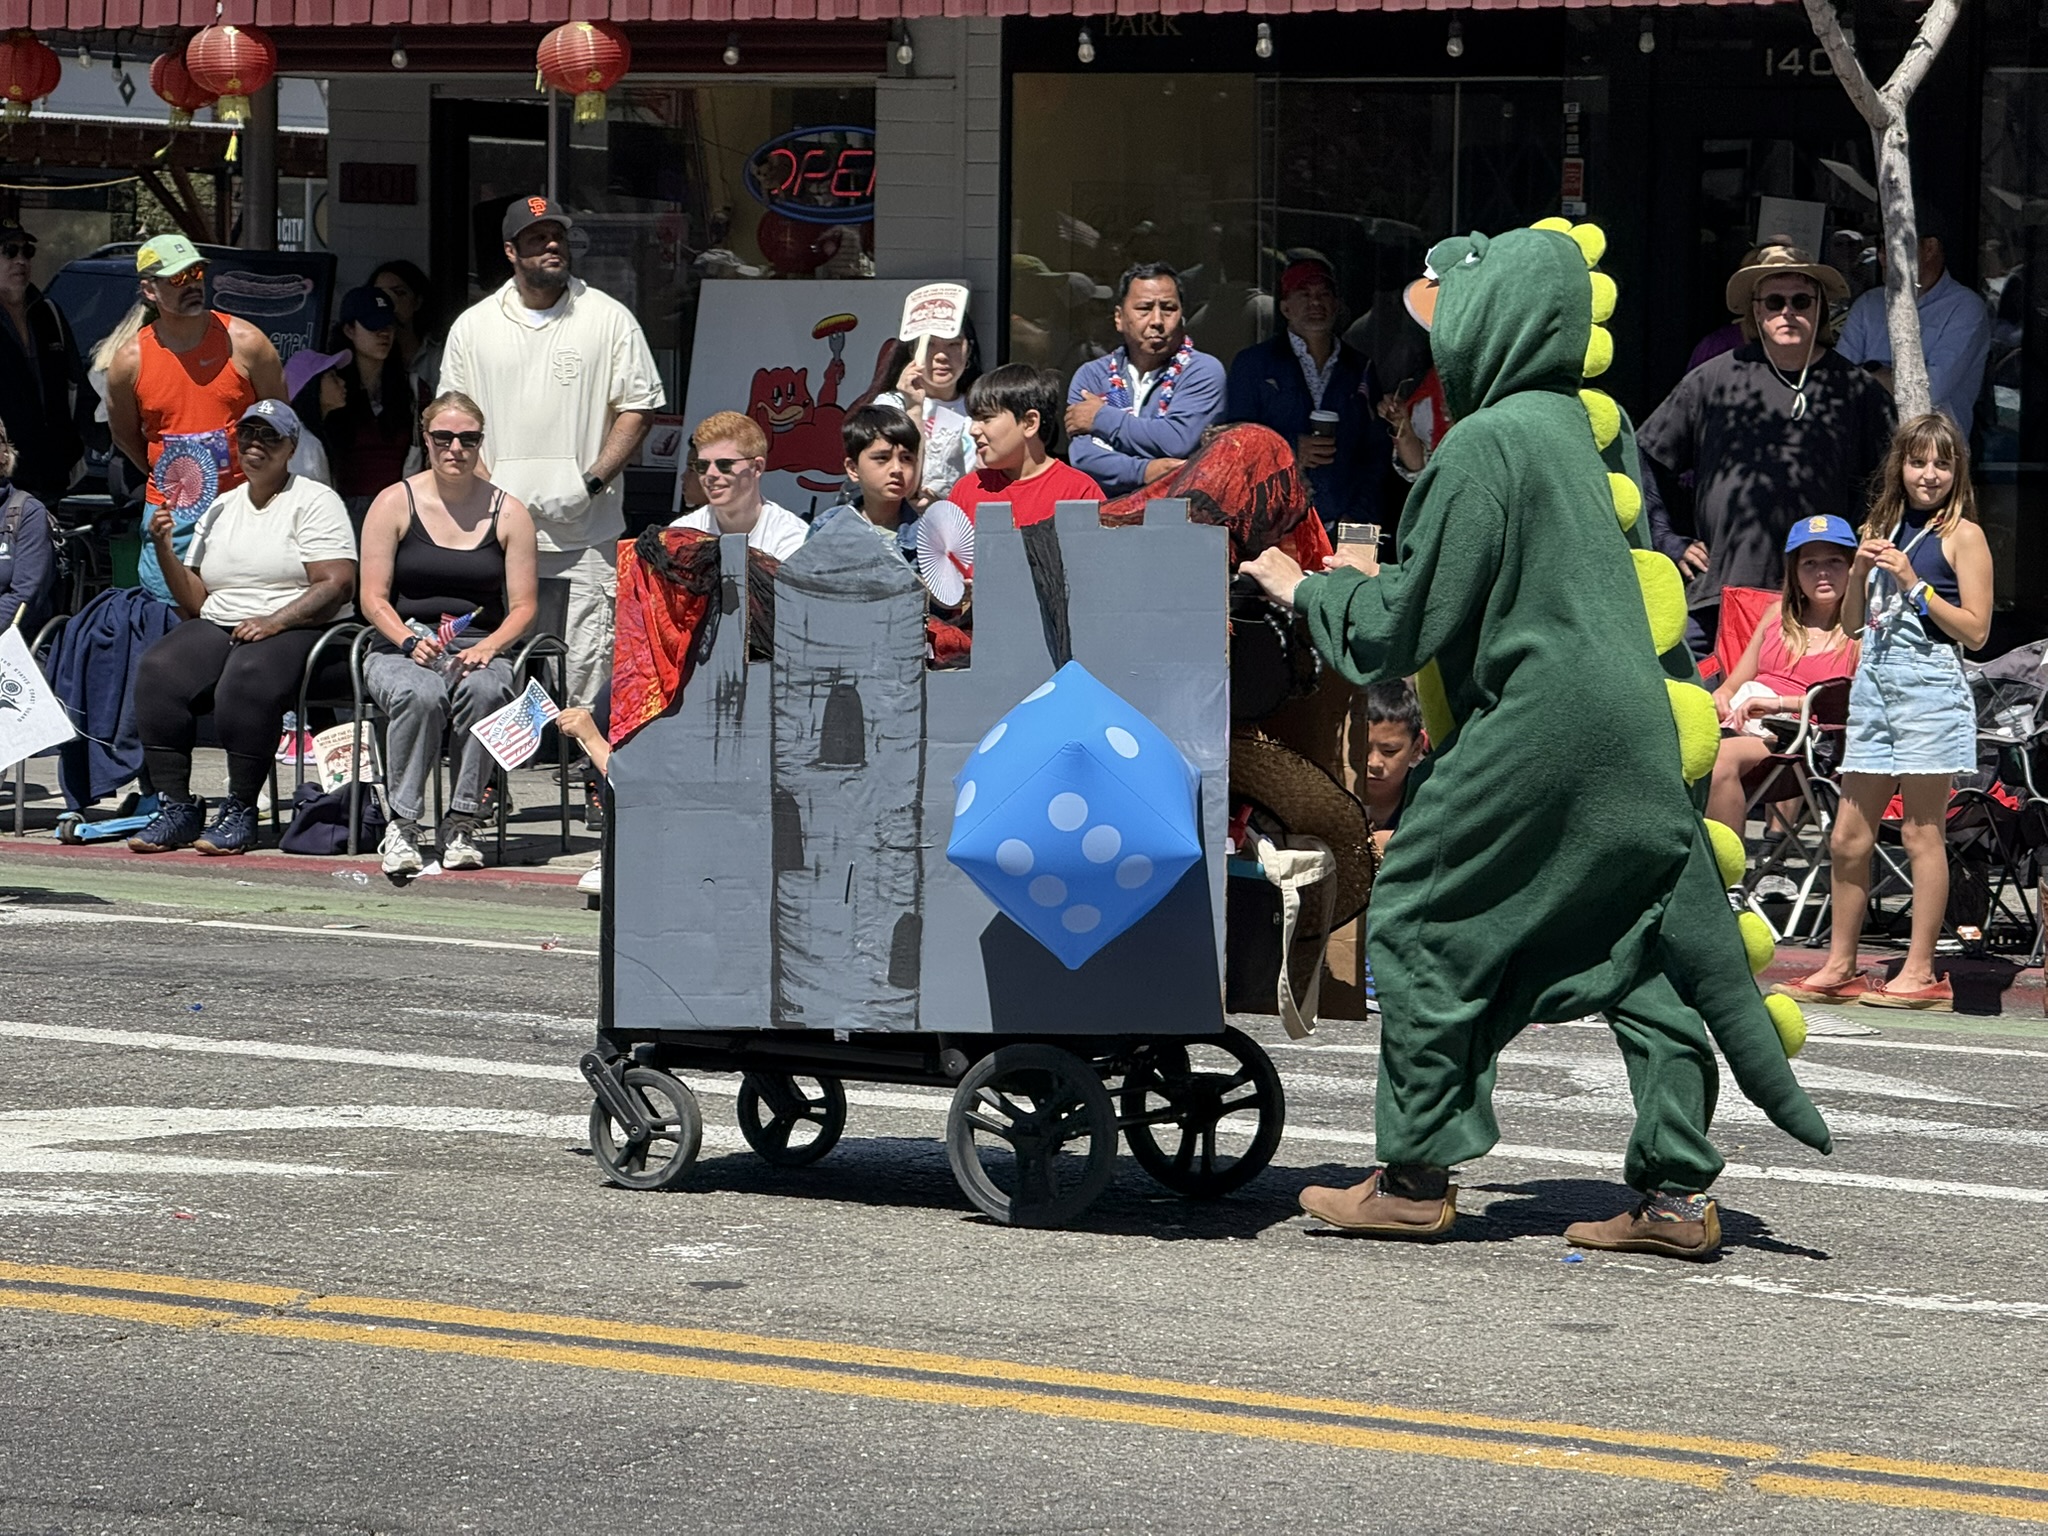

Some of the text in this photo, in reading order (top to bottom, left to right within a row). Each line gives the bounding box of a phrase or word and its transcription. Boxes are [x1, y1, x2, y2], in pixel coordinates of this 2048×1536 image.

[1104, 13, 1182, 36] PARK
[528, 196, 547, 217] SF
[258, 400, 274, 415] LA
[491, 726, 501, 739] NO
[500, 707, 517, 726] KINGS
